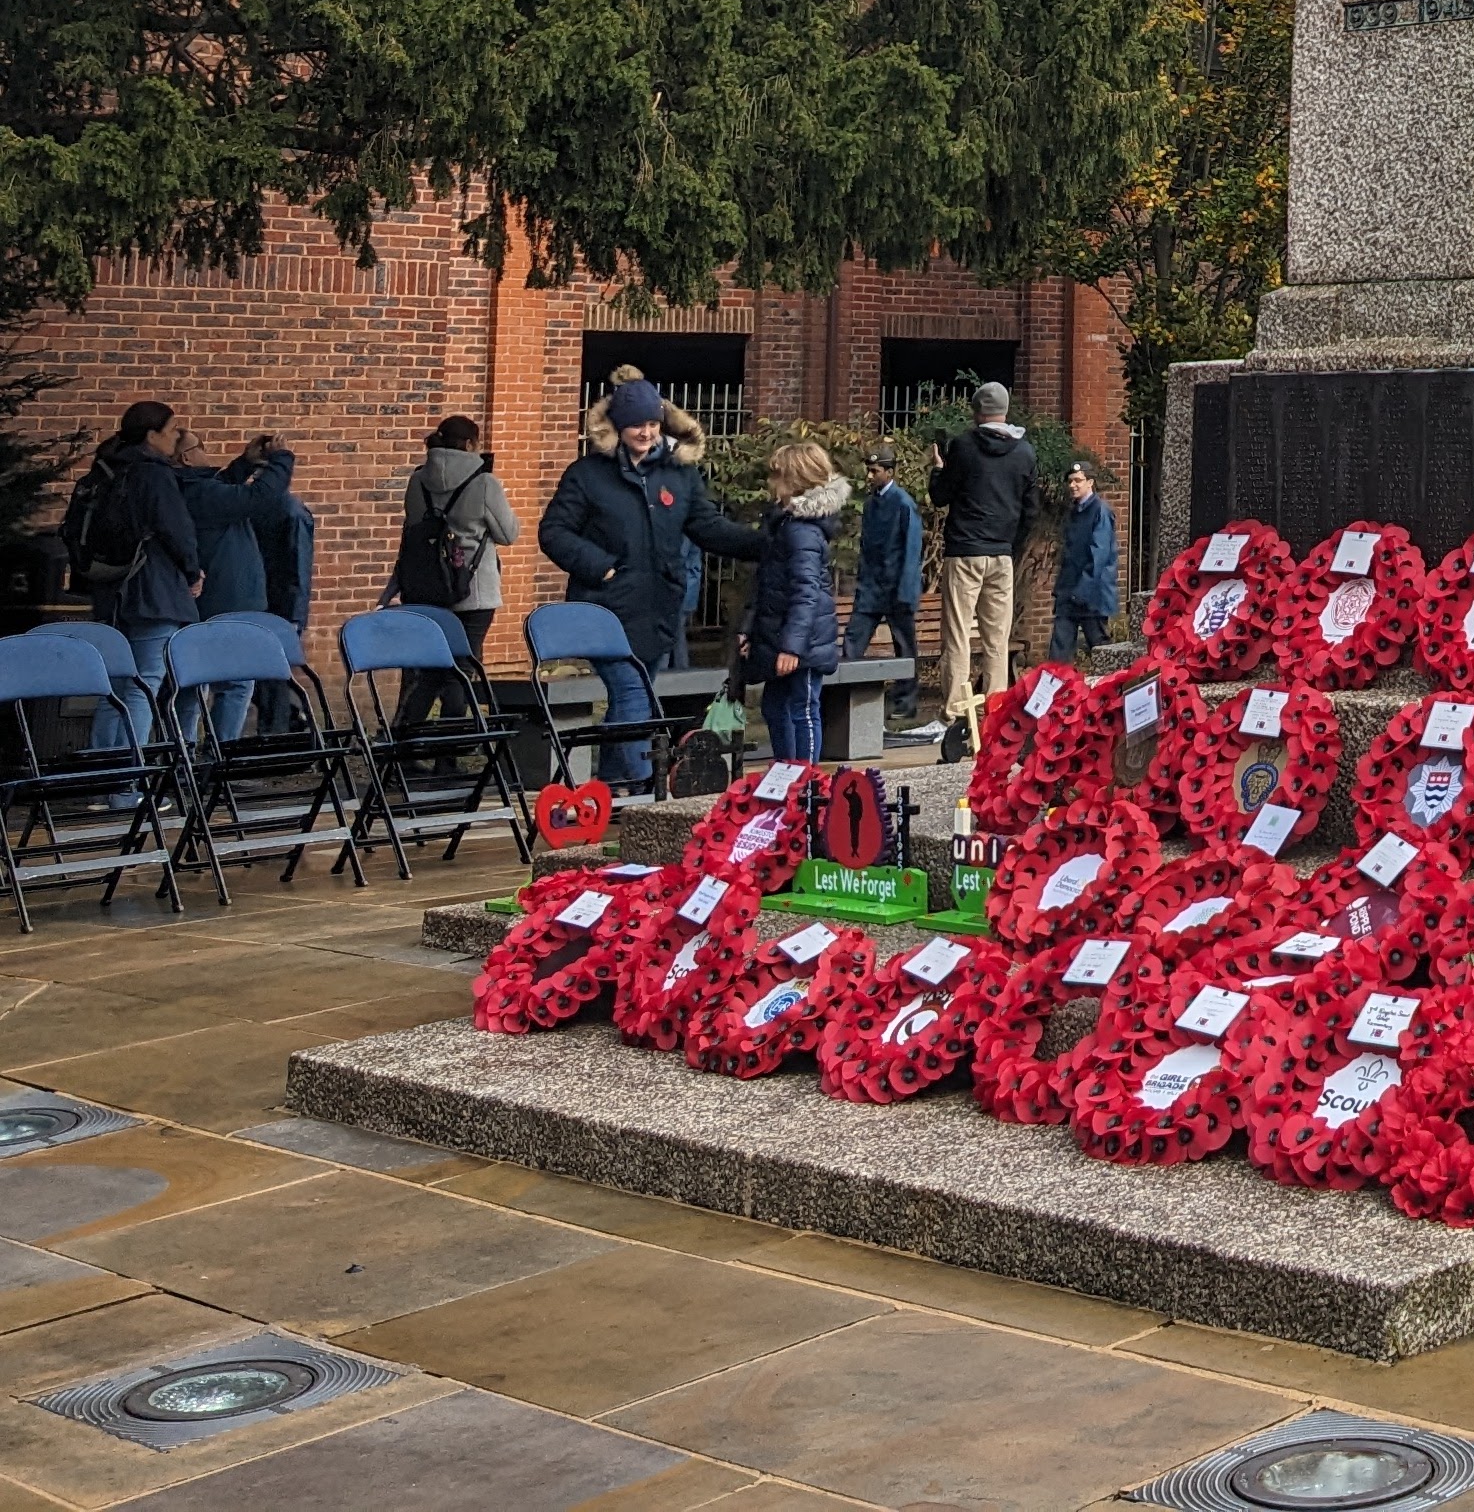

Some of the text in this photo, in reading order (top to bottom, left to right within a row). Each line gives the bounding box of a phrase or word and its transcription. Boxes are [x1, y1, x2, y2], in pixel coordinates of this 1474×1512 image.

[1344, 2, 1398, 30] 1939
[815, 866, 897, 903] Lest We Forget
[956, 864, 980, 891] Lest
[1348, 911, 1361, 934] POND
[1358, 906, 1372, 933] RIPPLE
[1145, 1080, 1186, 1090] BRIGADE
